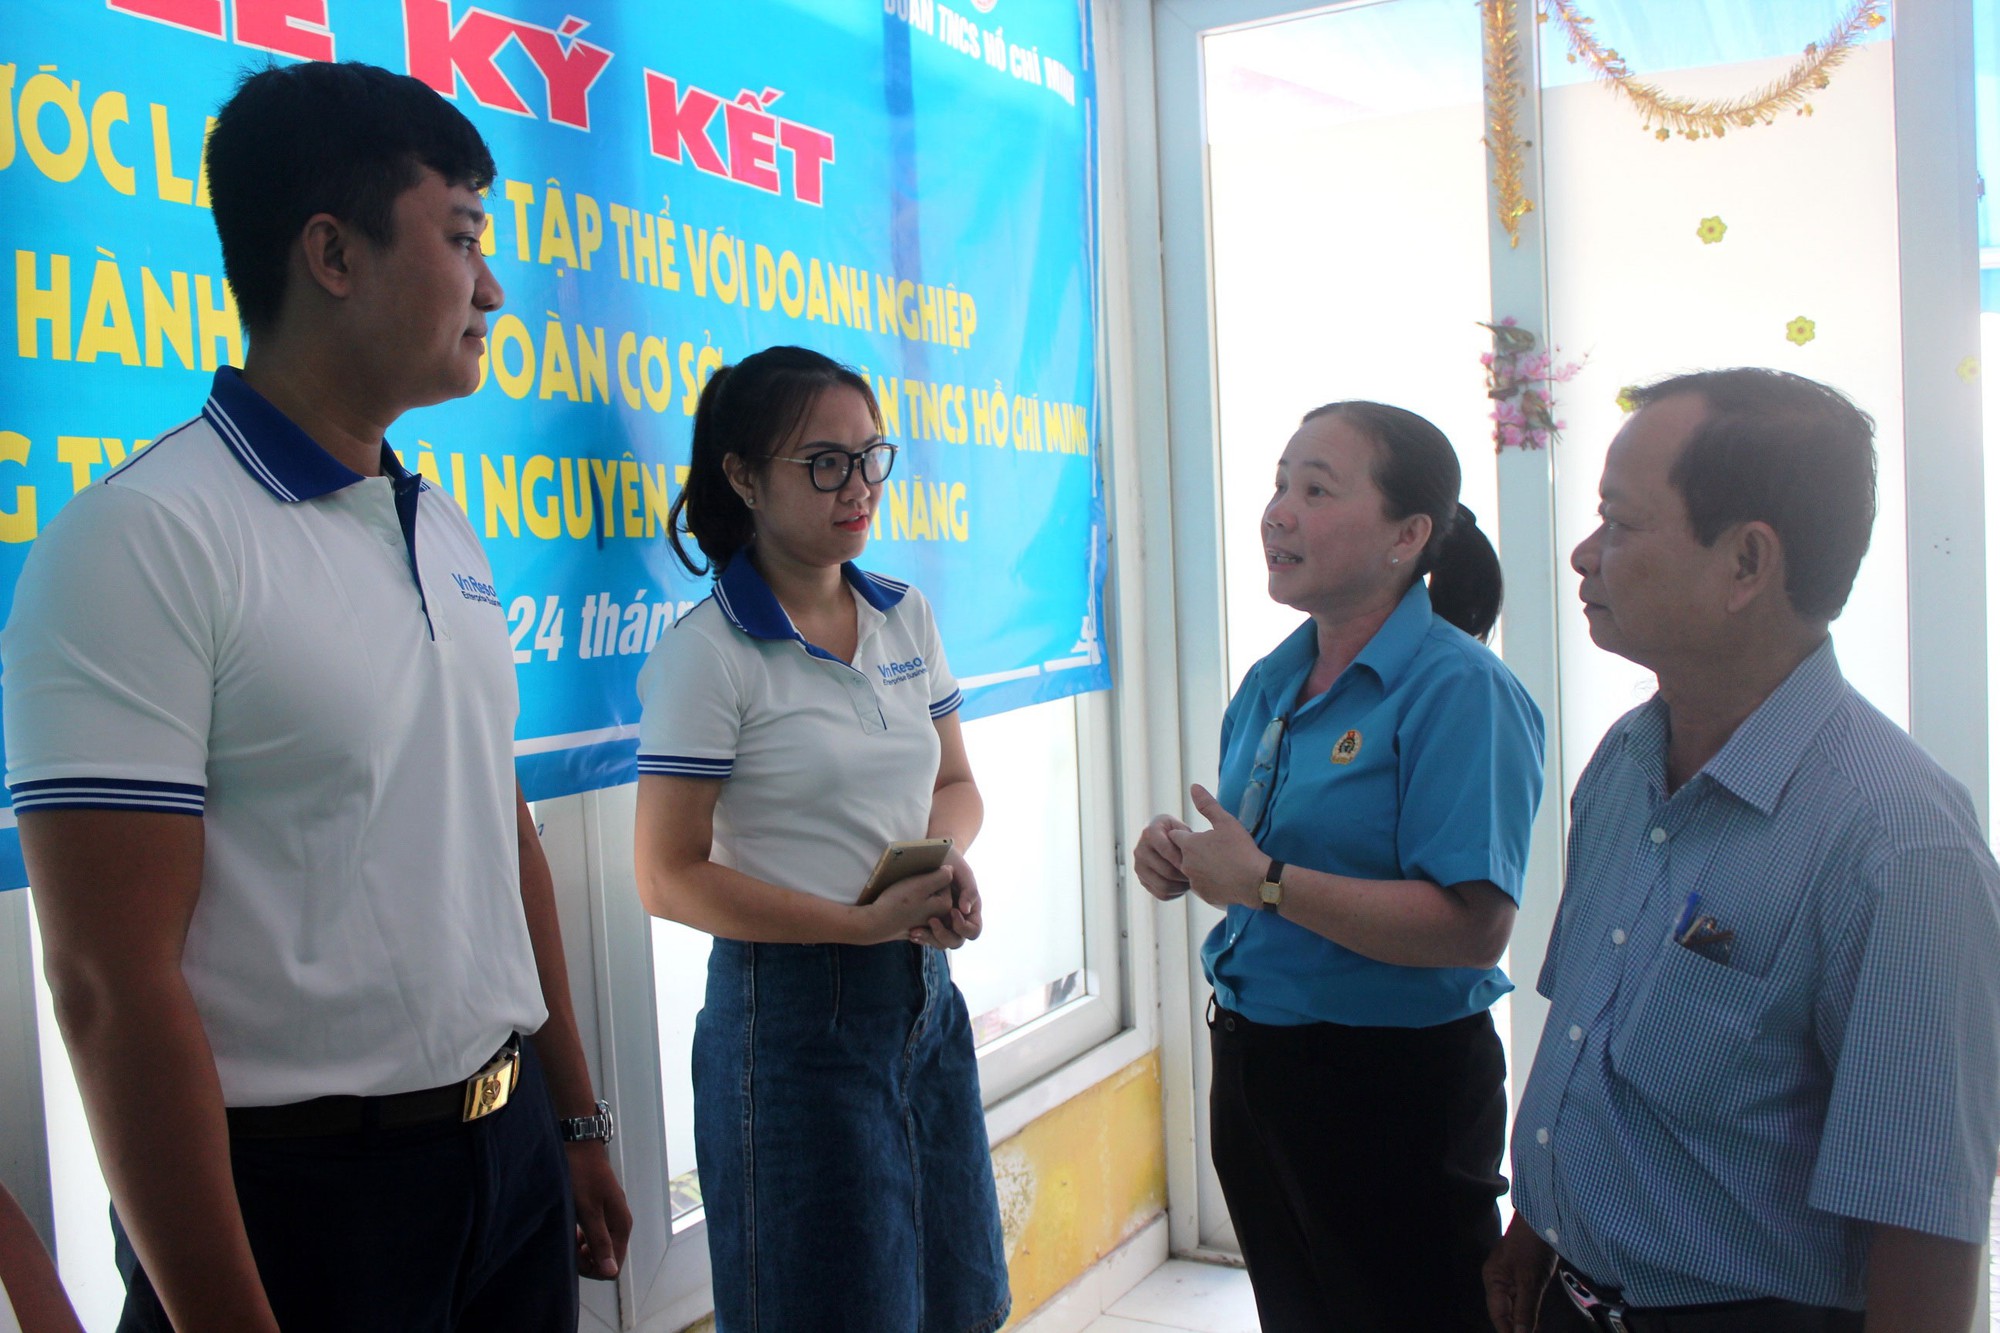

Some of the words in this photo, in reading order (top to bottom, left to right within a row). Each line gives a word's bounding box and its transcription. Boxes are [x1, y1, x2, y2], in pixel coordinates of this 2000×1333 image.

[402, 0, 615, 133] KÝ
[642, 66, 835, 208] KẾT
[937, 3, 981, 60] TNCS
[0, 62, 137, 196] ỚC
[505, 177, 603, 278] TẬP
[609, 194, 681, 292] THỂ
[682, 223, 751, 308] VỚI
[754, 243, 873, 334] DOANH
[875, 273, 978, 356] NGHIỆP
[15, 245, 245, 371] HÀNH
[617, 331, 672, 413] CƠ
[904, 379, 969, 445] TNCS
[971, 377, 1010, 448] HỒ
[1011, 392, 1044, 452] CHÍ
[1044, 401, 1090, 456] MINH
[480, 450, 670, 540] NGUYÊN
[887, 474, 969, 542] NĂNG
[507, 595, 565, 664] 24
[579, 588, 695, 660] thán
